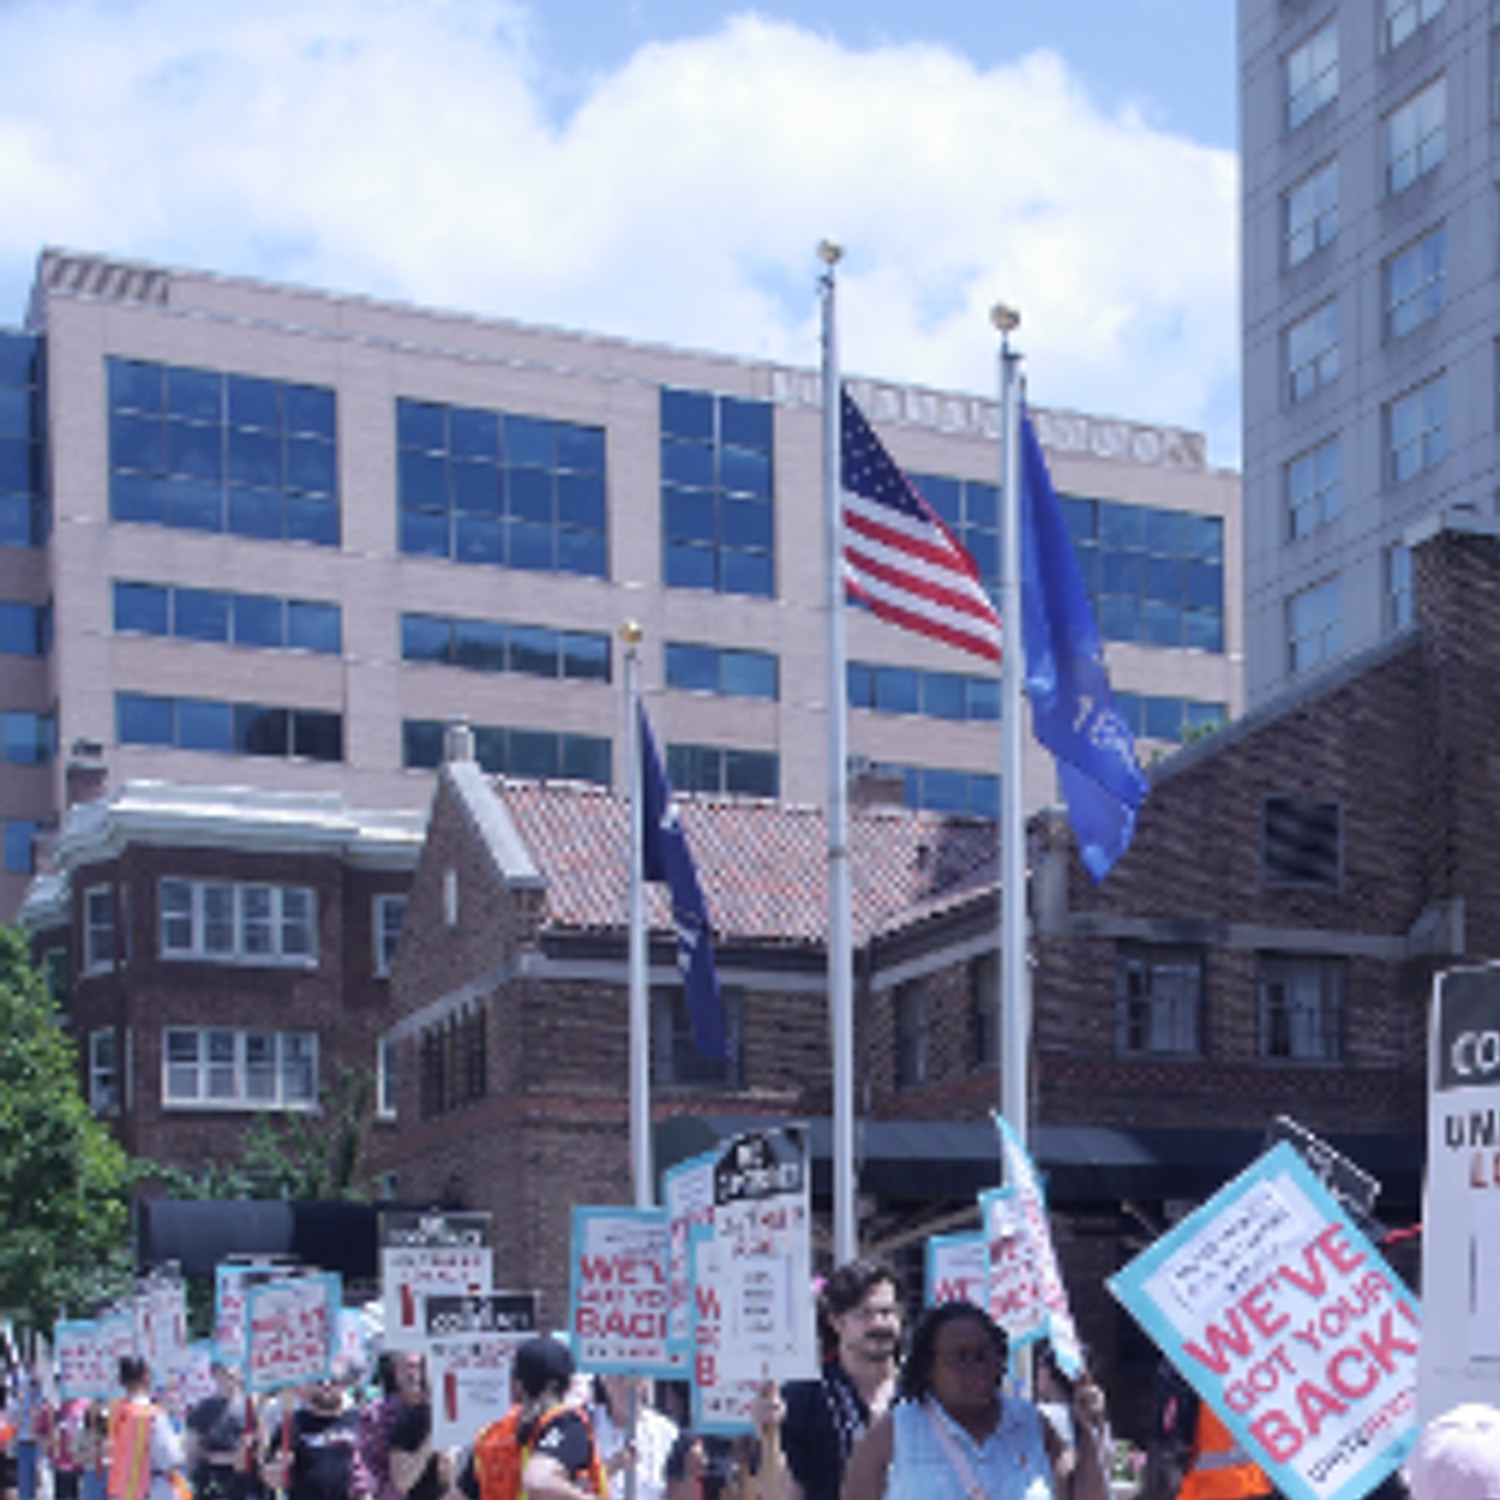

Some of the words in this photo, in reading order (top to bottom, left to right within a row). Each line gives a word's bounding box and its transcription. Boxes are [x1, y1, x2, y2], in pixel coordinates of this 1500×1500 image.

[1181, 1222, 1369, 1375] WE'VE
[1223, 1343, 1297, 1413] GOT
[1291, 1270, 1393, 1352] YOUR
[1248, 1300, 1422, 1465] BACK!
